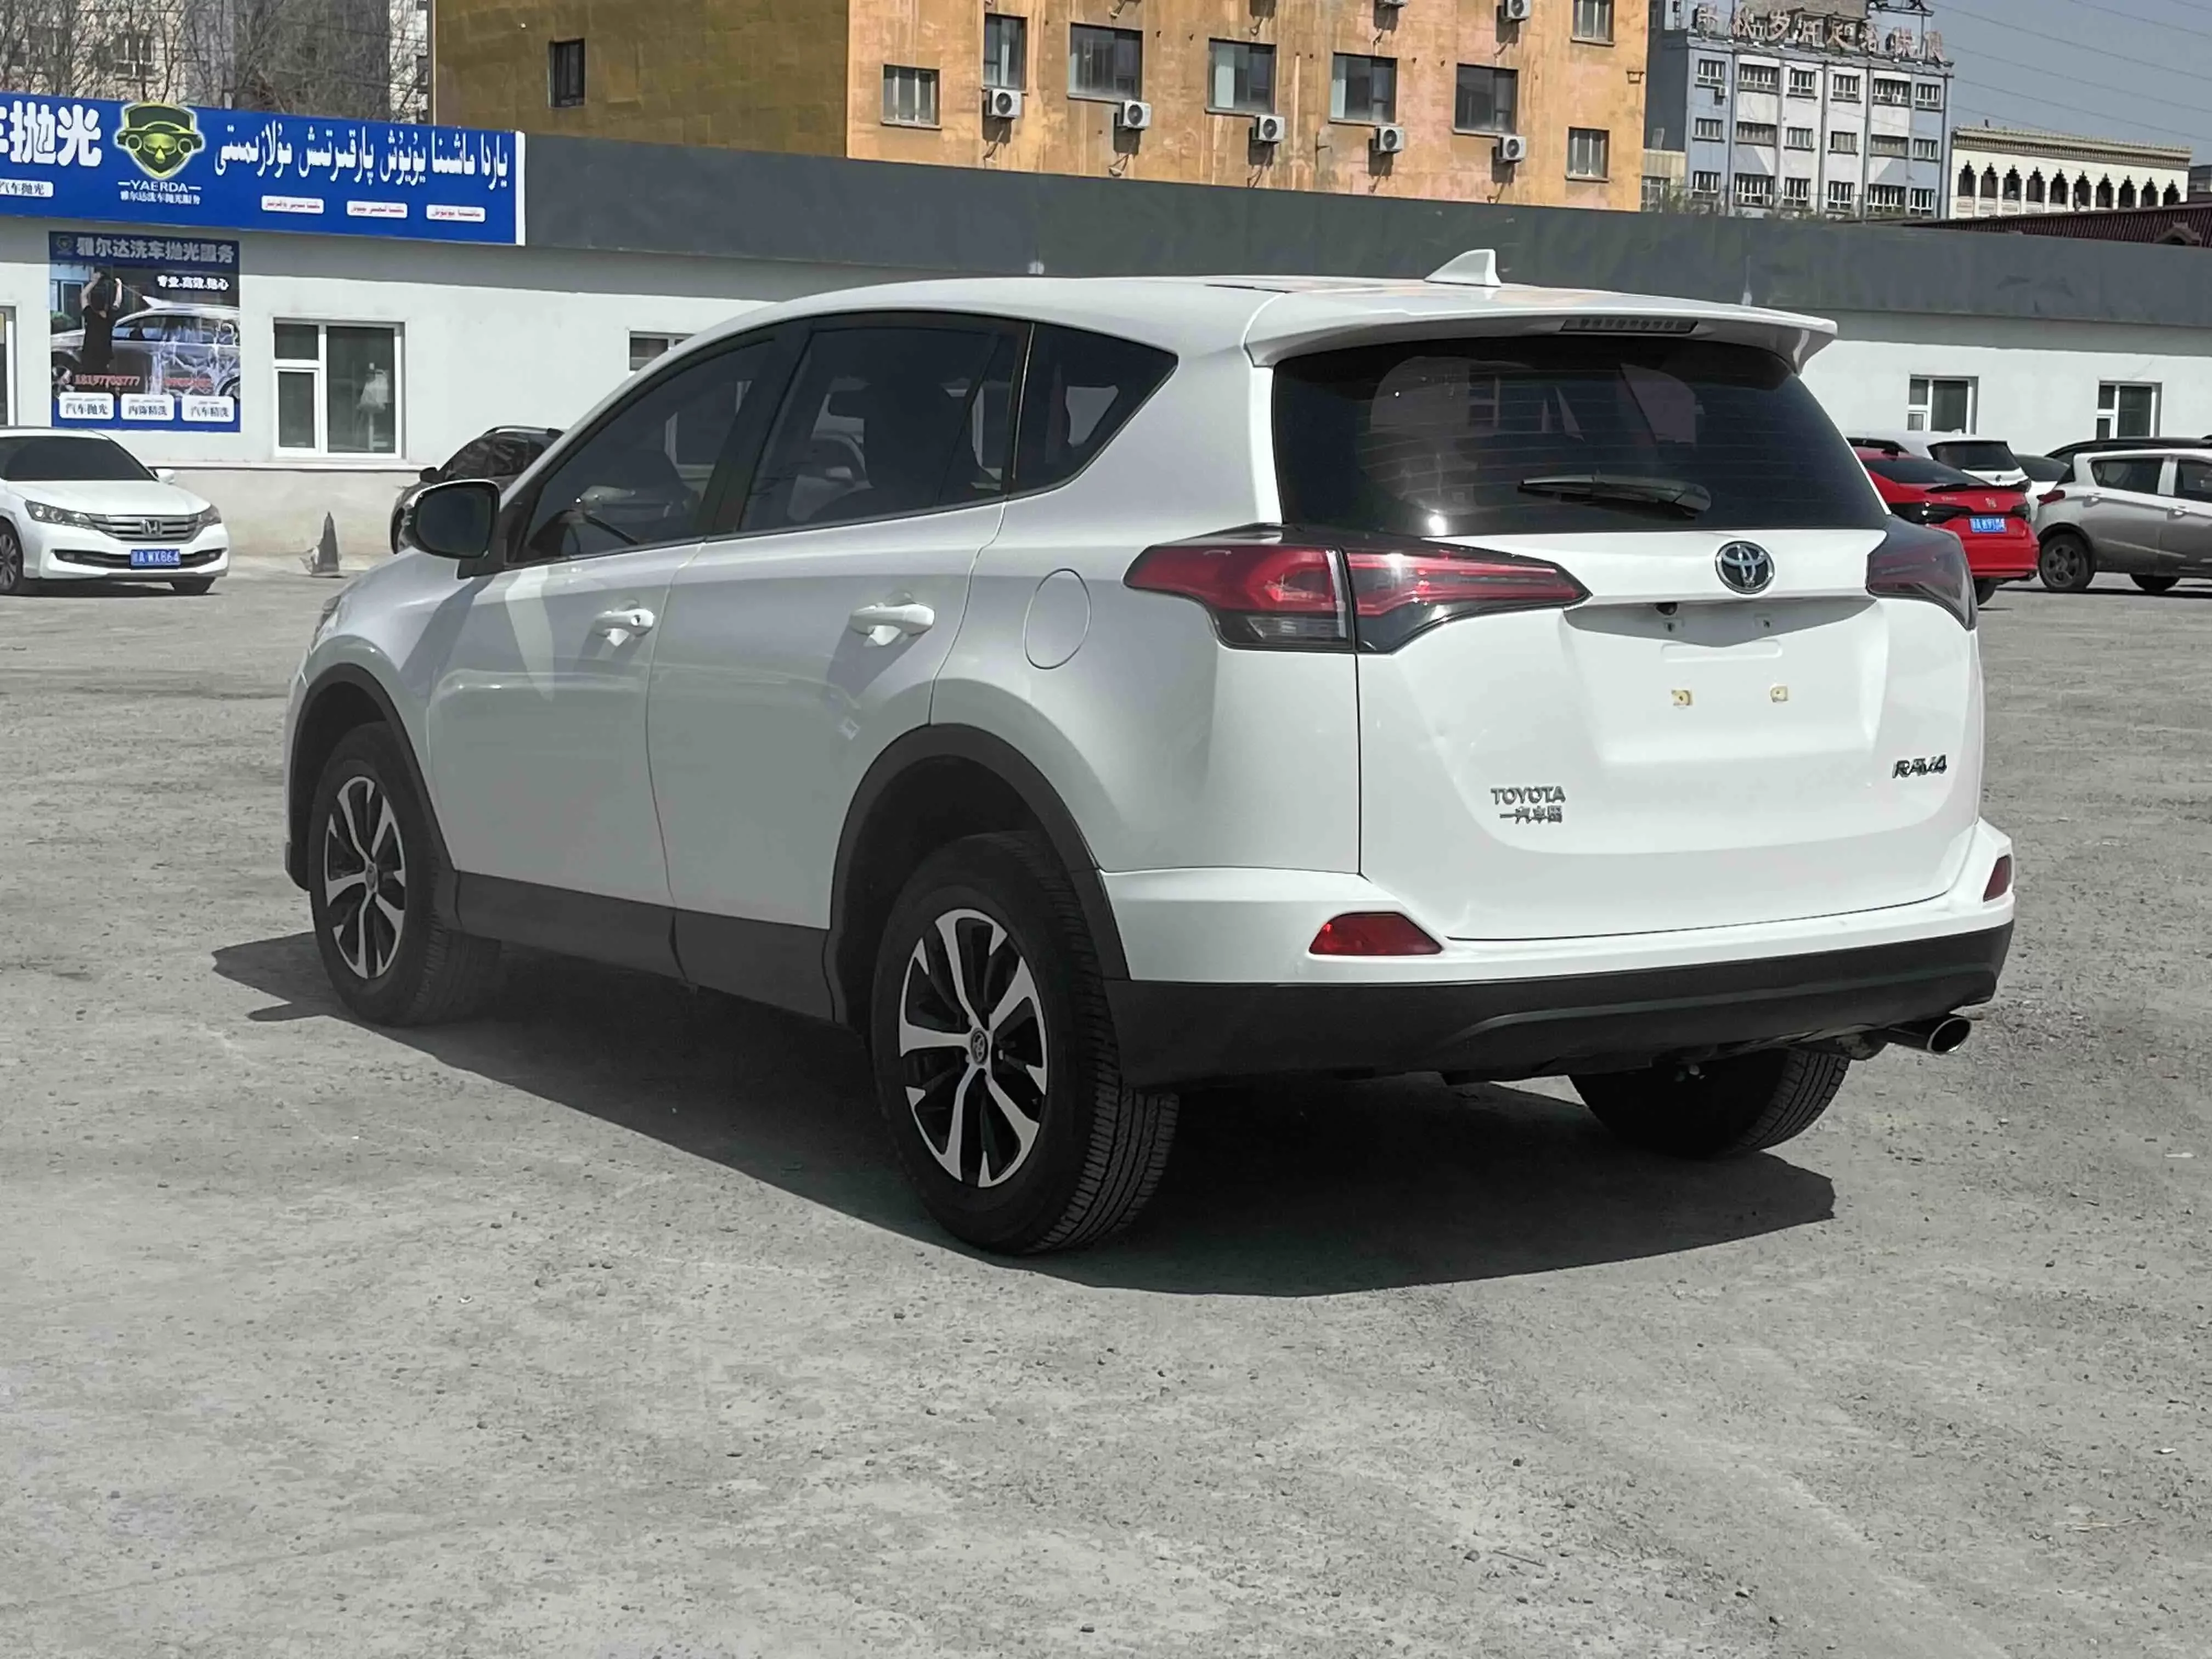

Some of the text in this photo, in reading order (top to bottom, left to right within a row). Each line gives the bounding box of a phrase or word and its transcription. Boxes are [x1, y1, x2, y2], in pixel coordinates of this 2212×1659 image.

[0, 101, 102, 167] 抛光
[130, 180, 188, 193] YAERDA
[1490, 786, 1566, 805] TOYOTA
